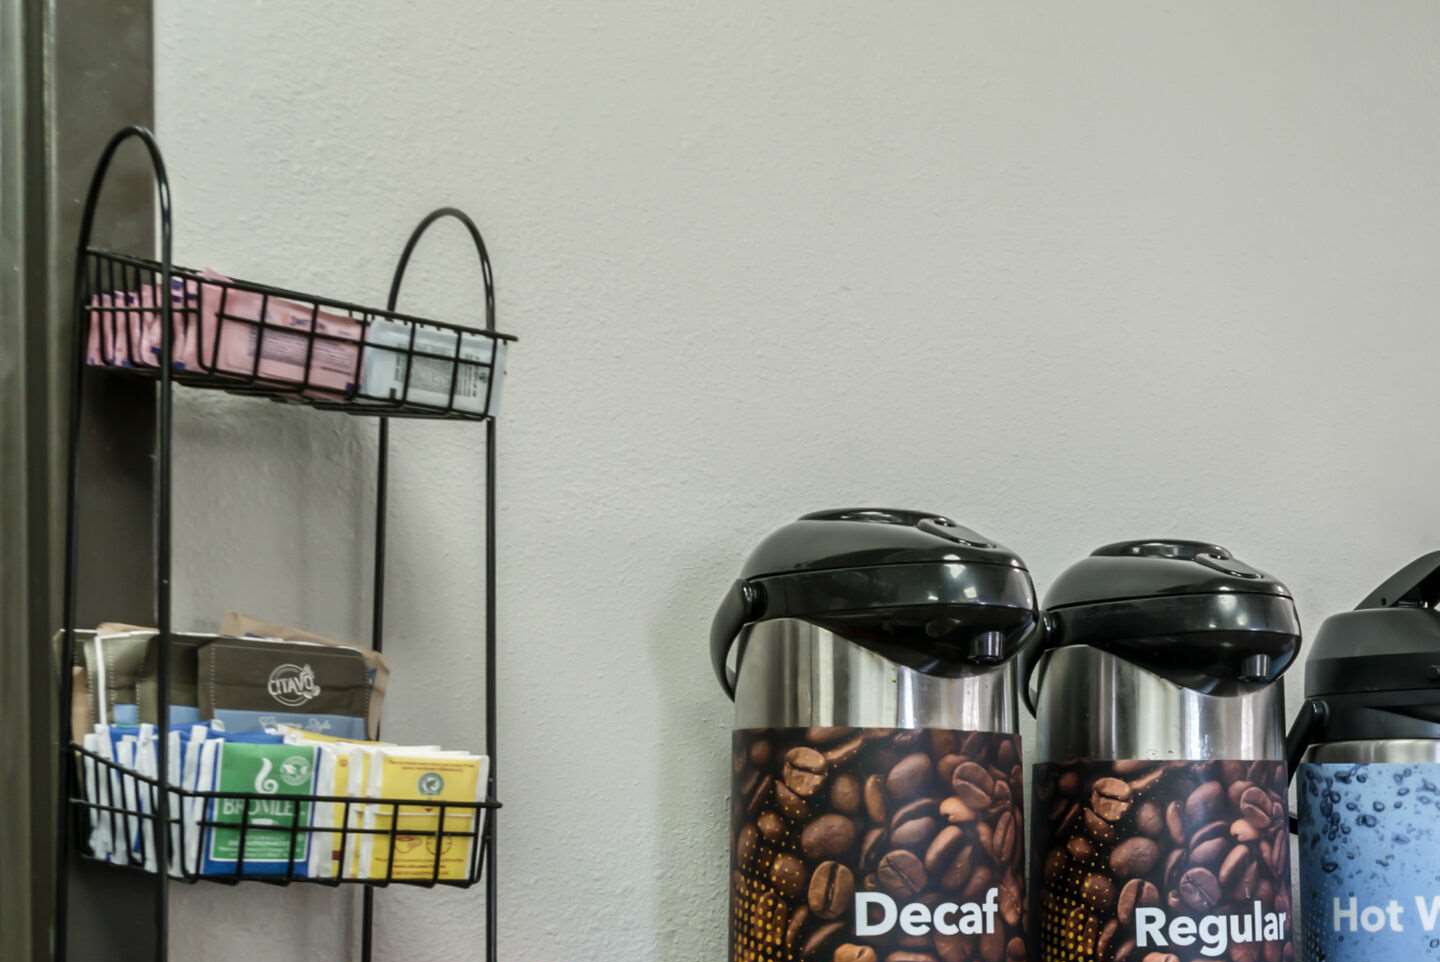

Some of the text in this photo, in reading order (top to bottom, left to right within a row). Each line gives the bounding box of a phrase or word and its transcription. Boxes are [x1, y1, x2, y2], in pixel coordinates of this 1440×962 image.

[855, 887, 999, 937] Decaf
[1135, 900, 1287, 957] Regular
[1333, 896, 1405, 933] Hot
